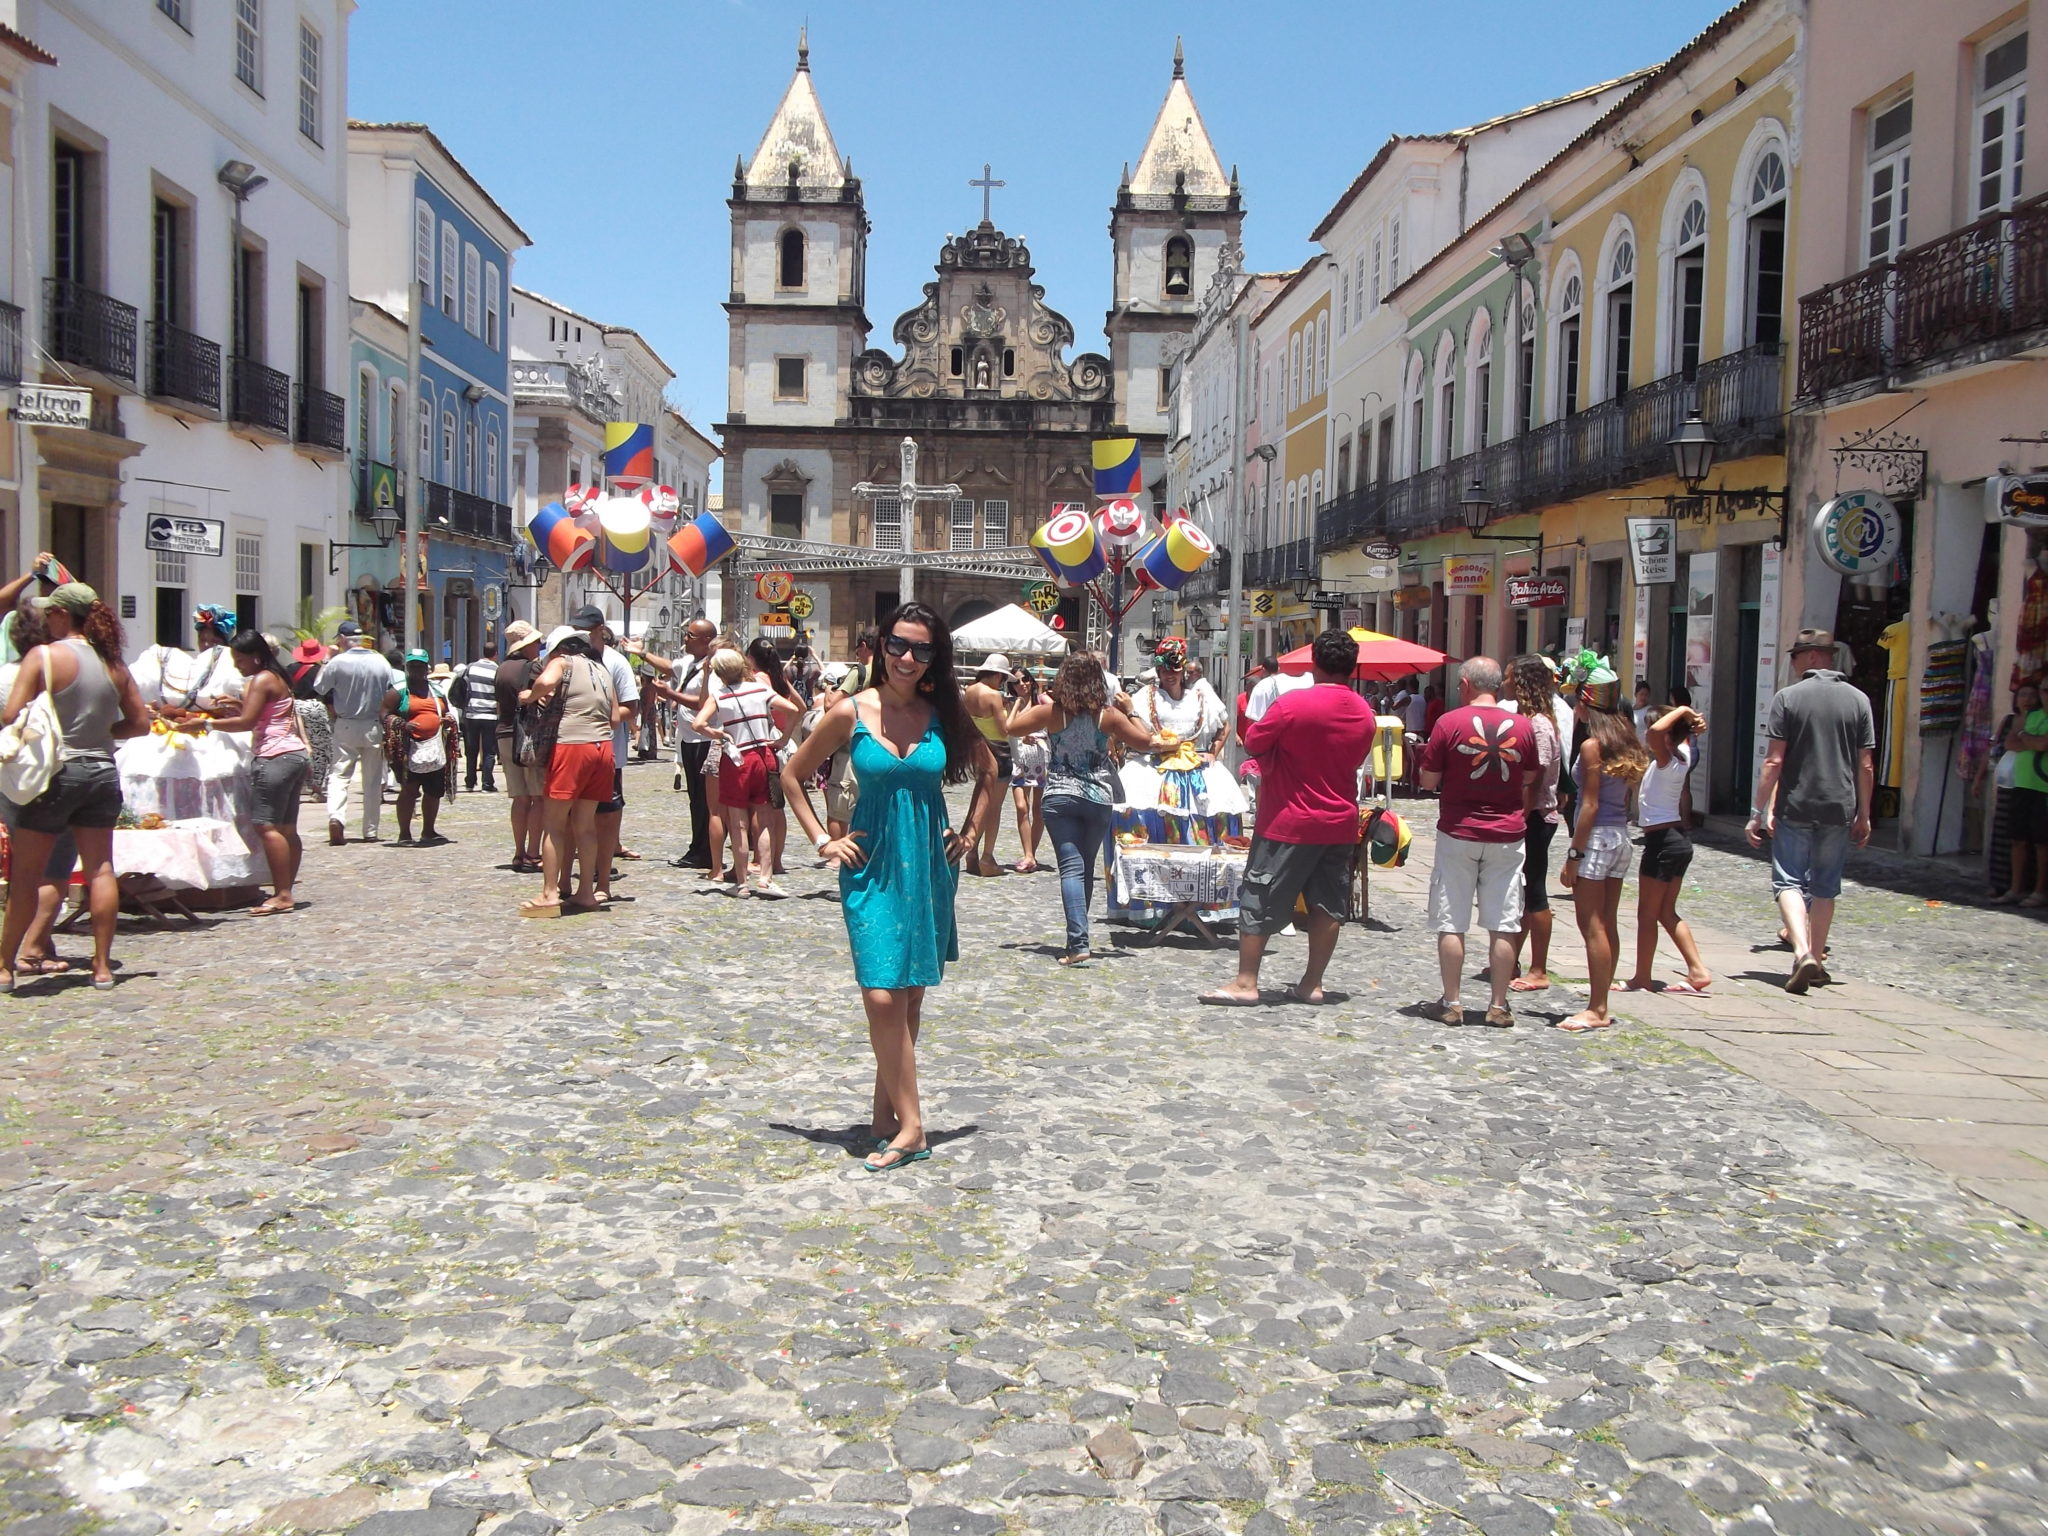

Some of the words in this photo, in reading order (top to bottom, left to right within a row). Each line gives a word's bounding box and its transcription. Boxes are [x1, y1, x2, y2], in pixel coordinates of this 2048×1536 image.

[17, 391, 81, 413] teltron
[1716, 484, 1769, 521] Agency
[1641, 565, 1669, 574] Reise
[1509, 582, 1540, 597] Bahia
[1540, 582, 1565, 594] Arte
